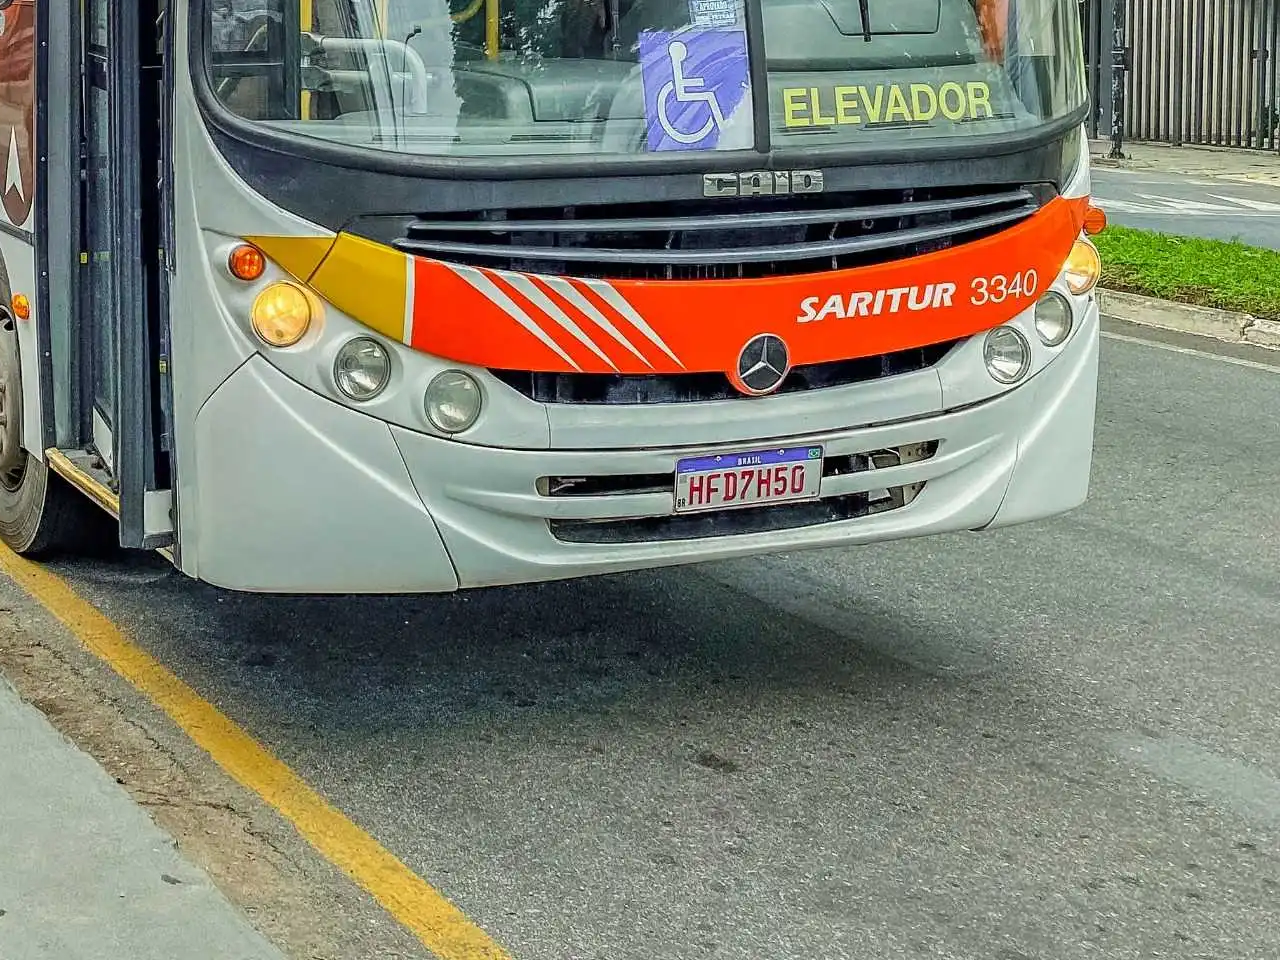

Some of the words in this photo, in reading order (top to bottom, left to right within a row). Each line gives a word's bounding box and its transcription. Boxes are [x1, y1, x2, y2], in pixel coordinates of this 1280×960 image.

[783, 81, 994, 128] ELEVADOR
[703, 170, 824, 197] CAIO
[796, 282, 957, 324] SARITUR
[970, 268, 1038, 306] 3340
[737, 455, 762, 466] BRASIL
[688, 464, 806, 506] HFD7H50
